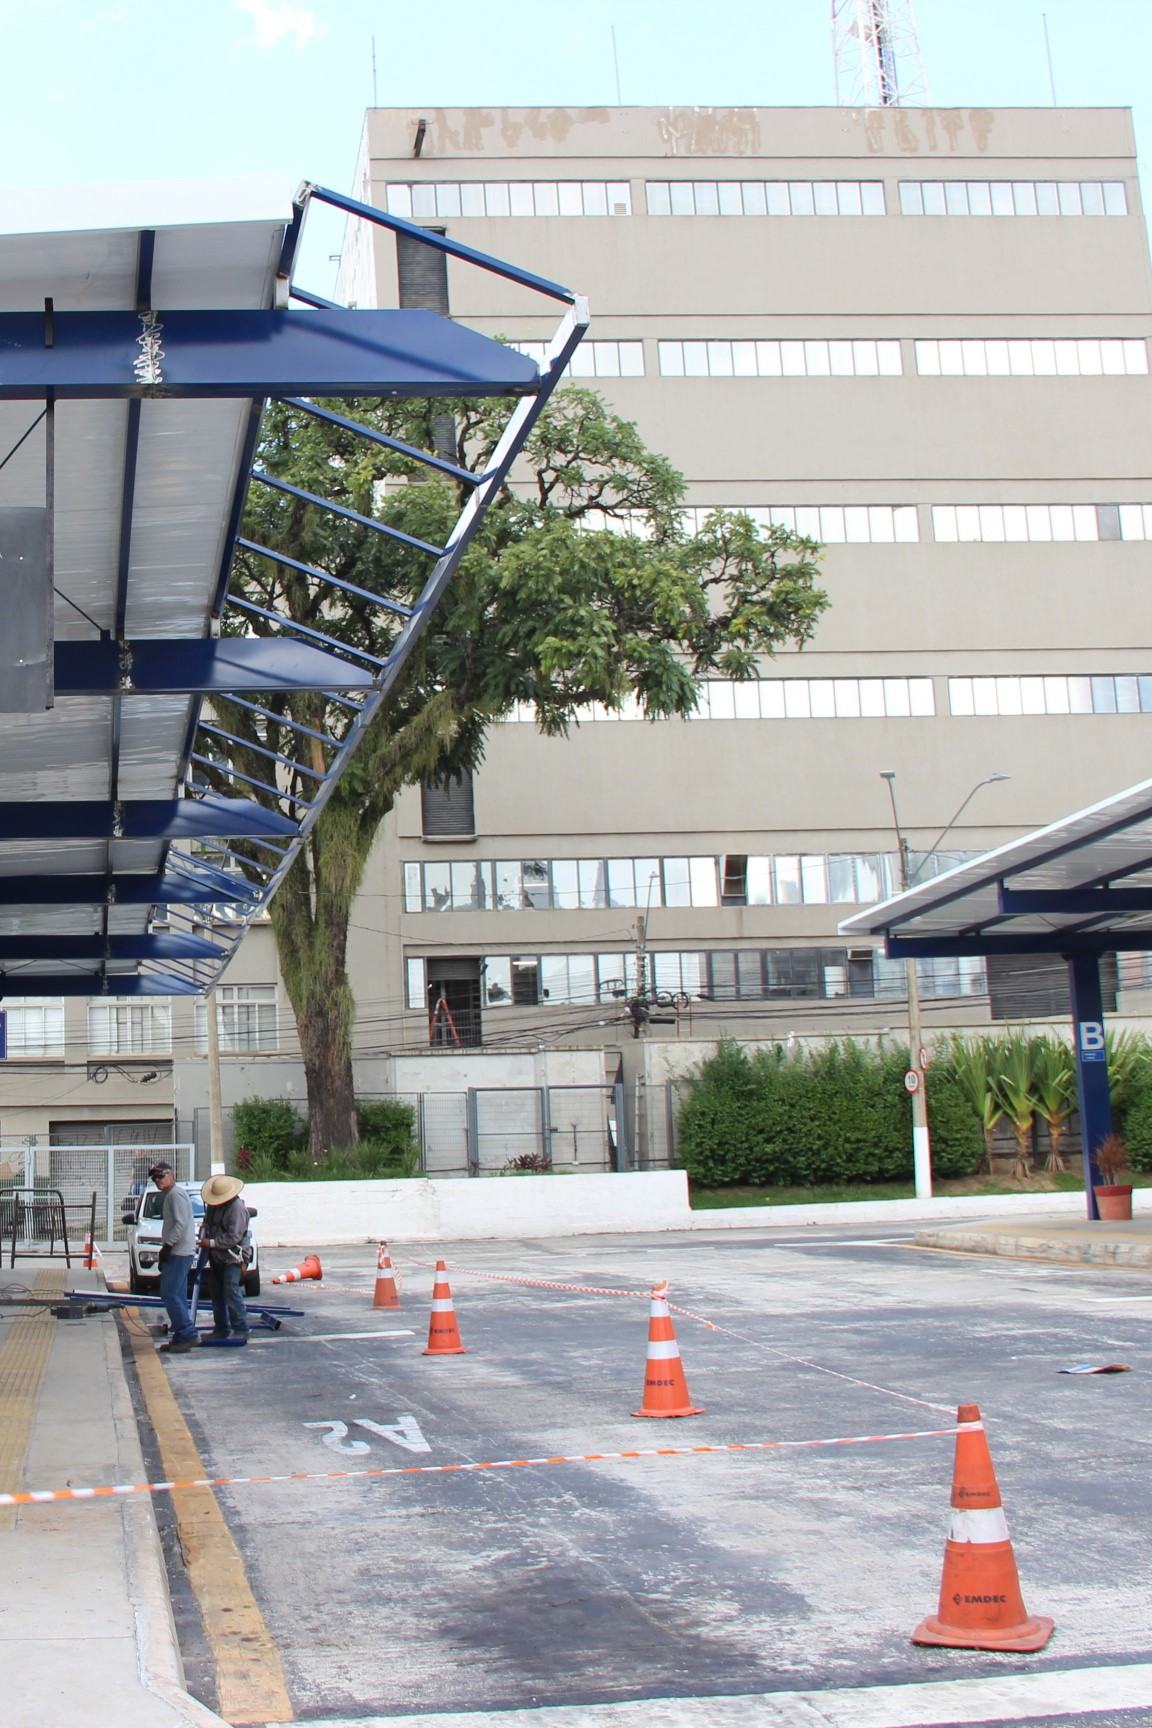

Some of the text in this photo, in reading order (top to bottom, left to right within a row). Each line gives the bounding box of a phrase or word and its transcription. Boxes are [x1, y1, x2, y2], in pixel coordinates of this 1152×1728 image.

[1079, 1022, 1104, 1050] B
[908, 1075, 916, 1084] 10
[964, 1594, 1007, 1604] EMDEC
